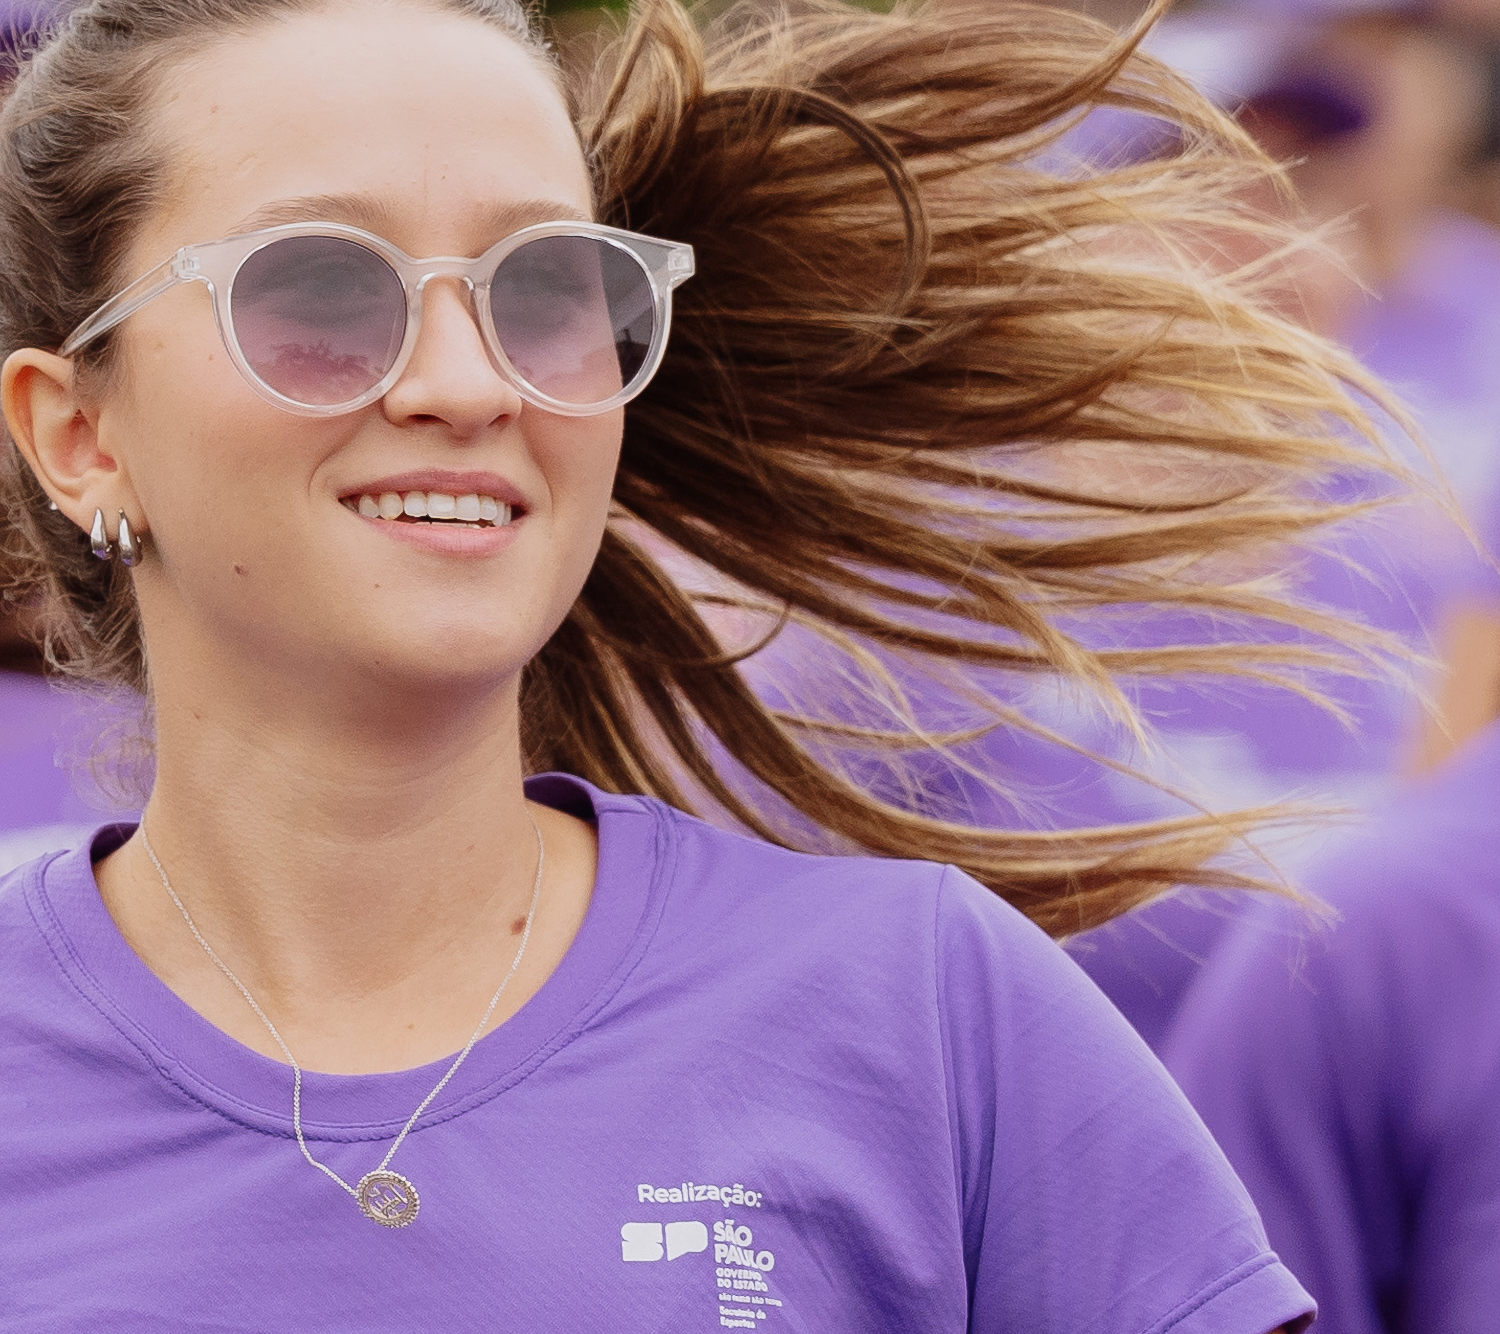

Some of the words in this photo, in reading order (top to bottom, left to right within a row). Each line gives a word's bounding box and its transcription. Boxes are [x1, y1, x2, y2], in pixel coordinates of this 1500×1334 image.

[637, 1181, 763, 1208] Realização:
[713, 1219, 753, 1247] SÃO
[714, 1243, 775, 1272] PAULO
